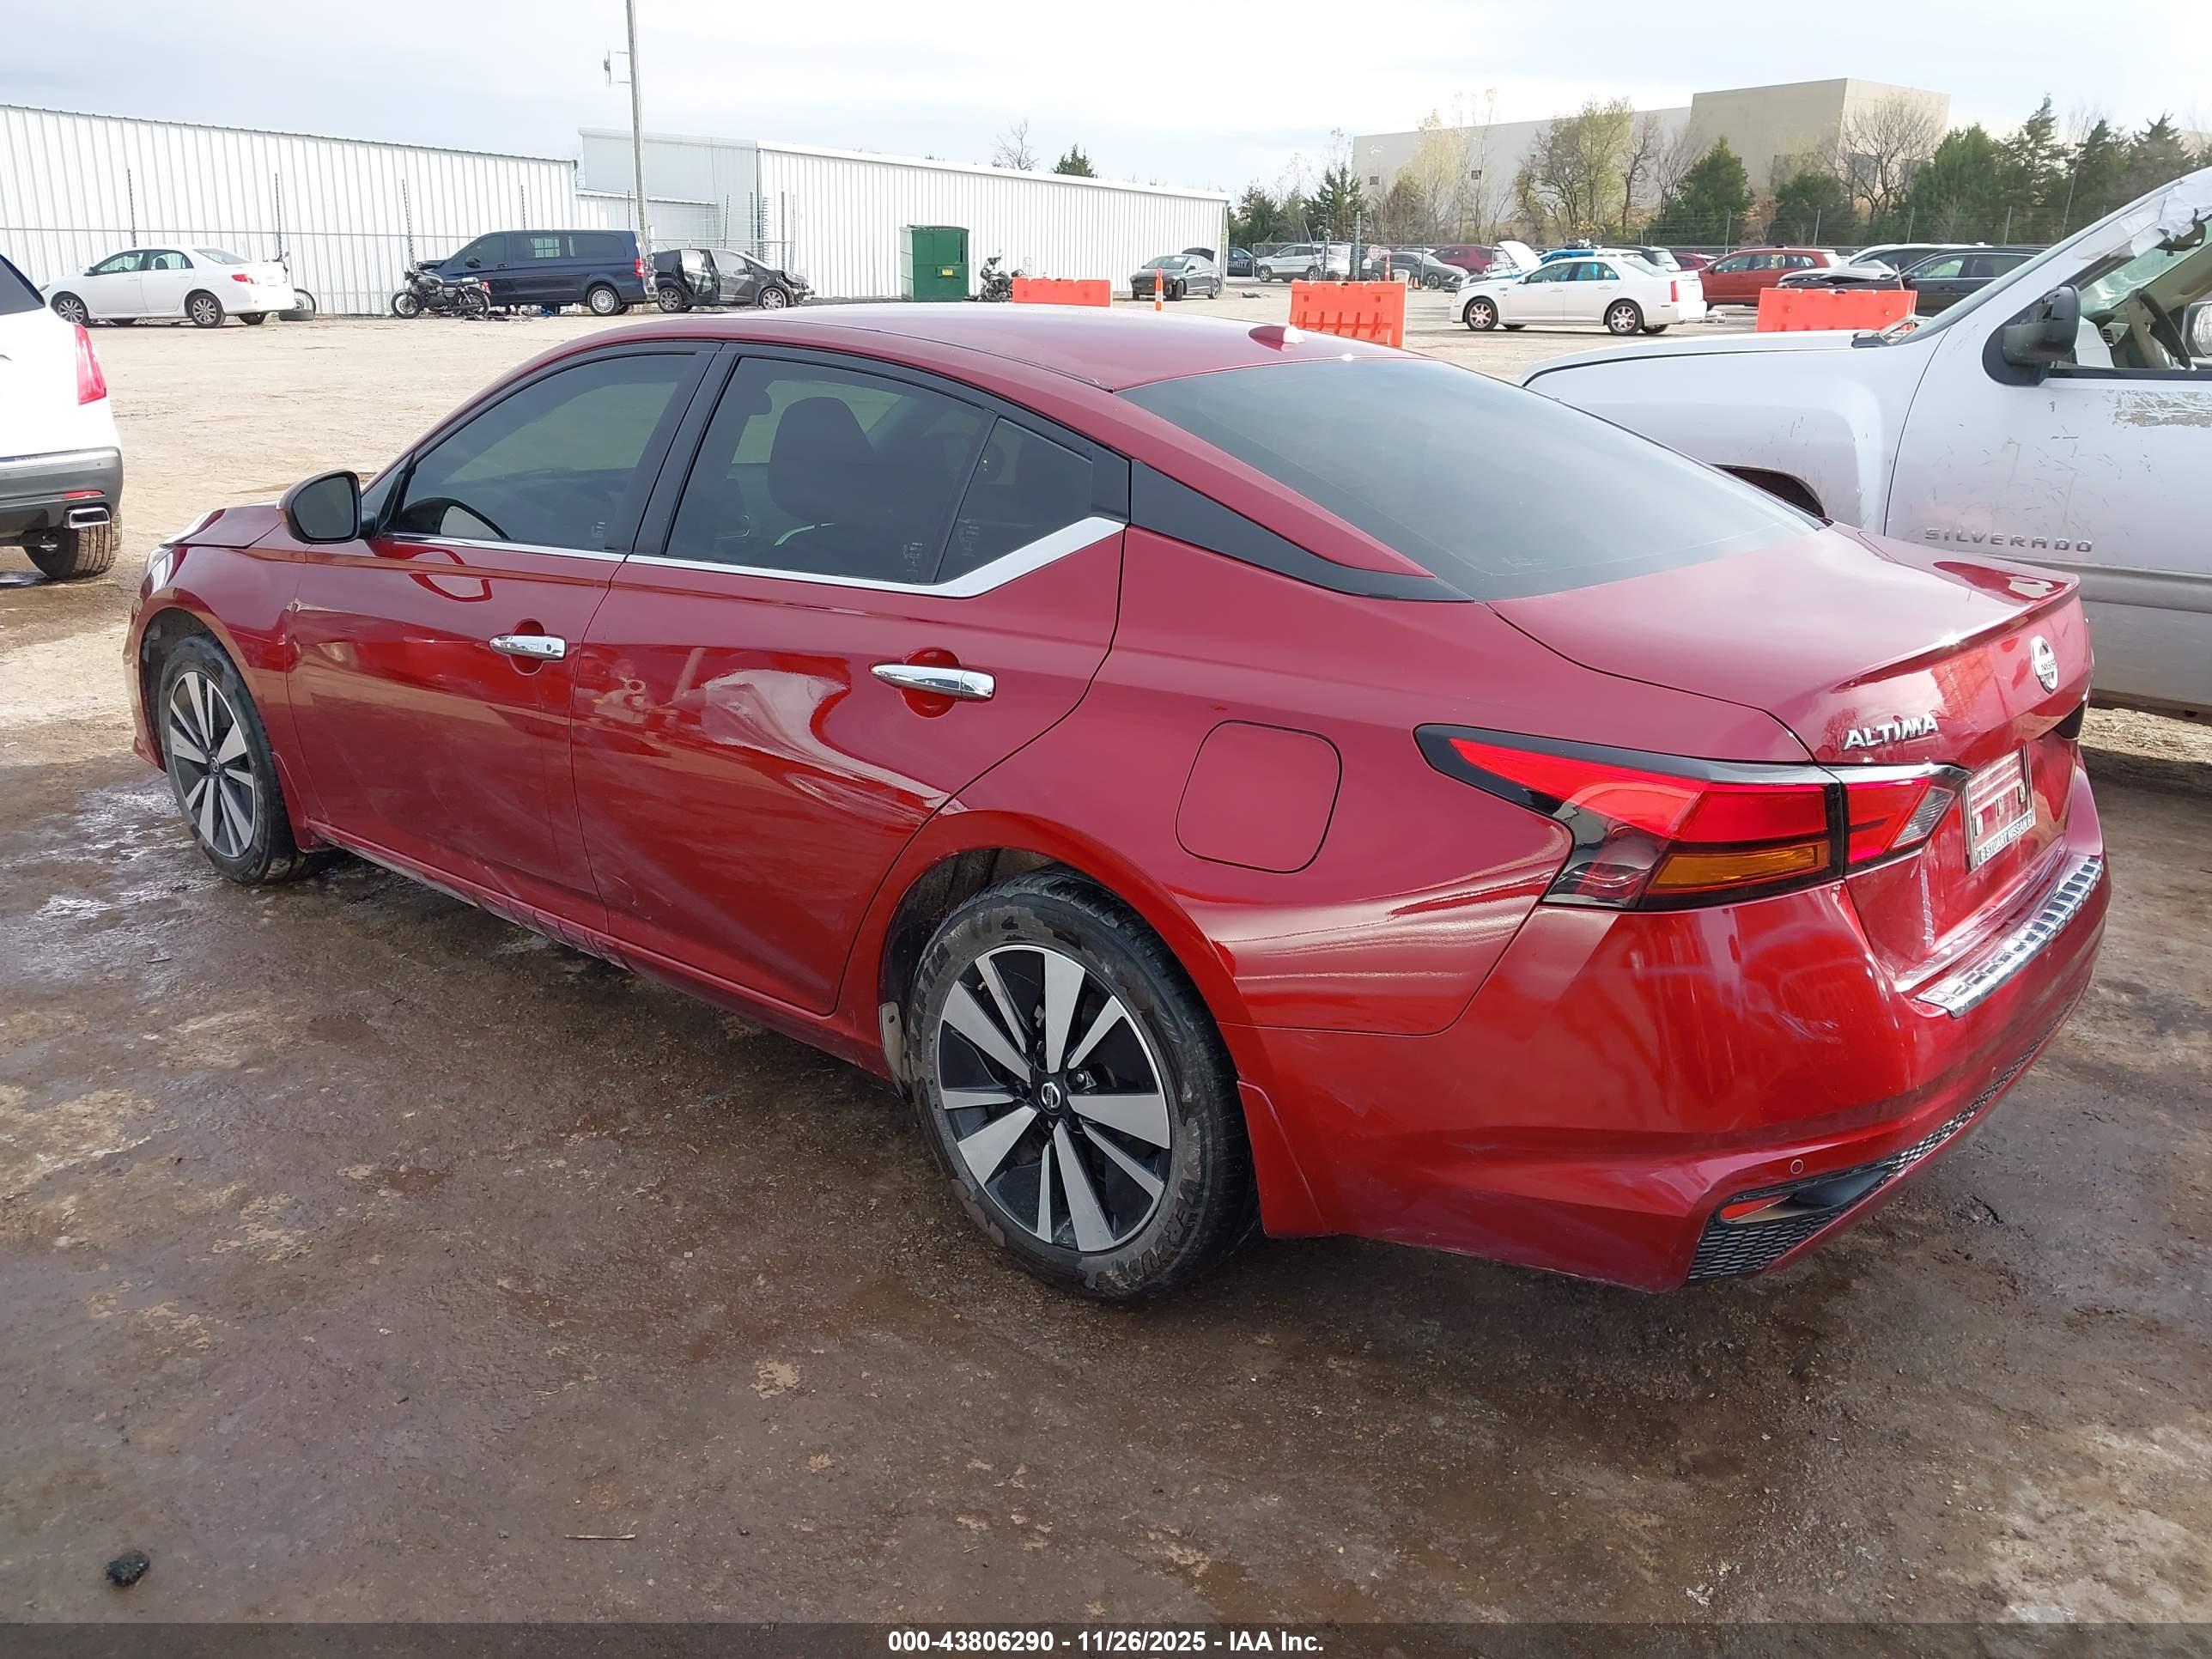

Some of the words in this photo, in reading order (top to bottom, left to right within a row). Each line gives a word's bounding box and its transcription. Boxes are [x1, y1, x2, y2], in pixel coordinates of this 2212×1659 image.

[1227, 260, 1248, 269] CURITY
[1924, 528, 2093, 552] SILVERADO
[1842, 714, 1939, 750] ALTIMA
[1986, 832, 2008, 854] STUART
[2008, 819, 2028, 839] NISSAN
